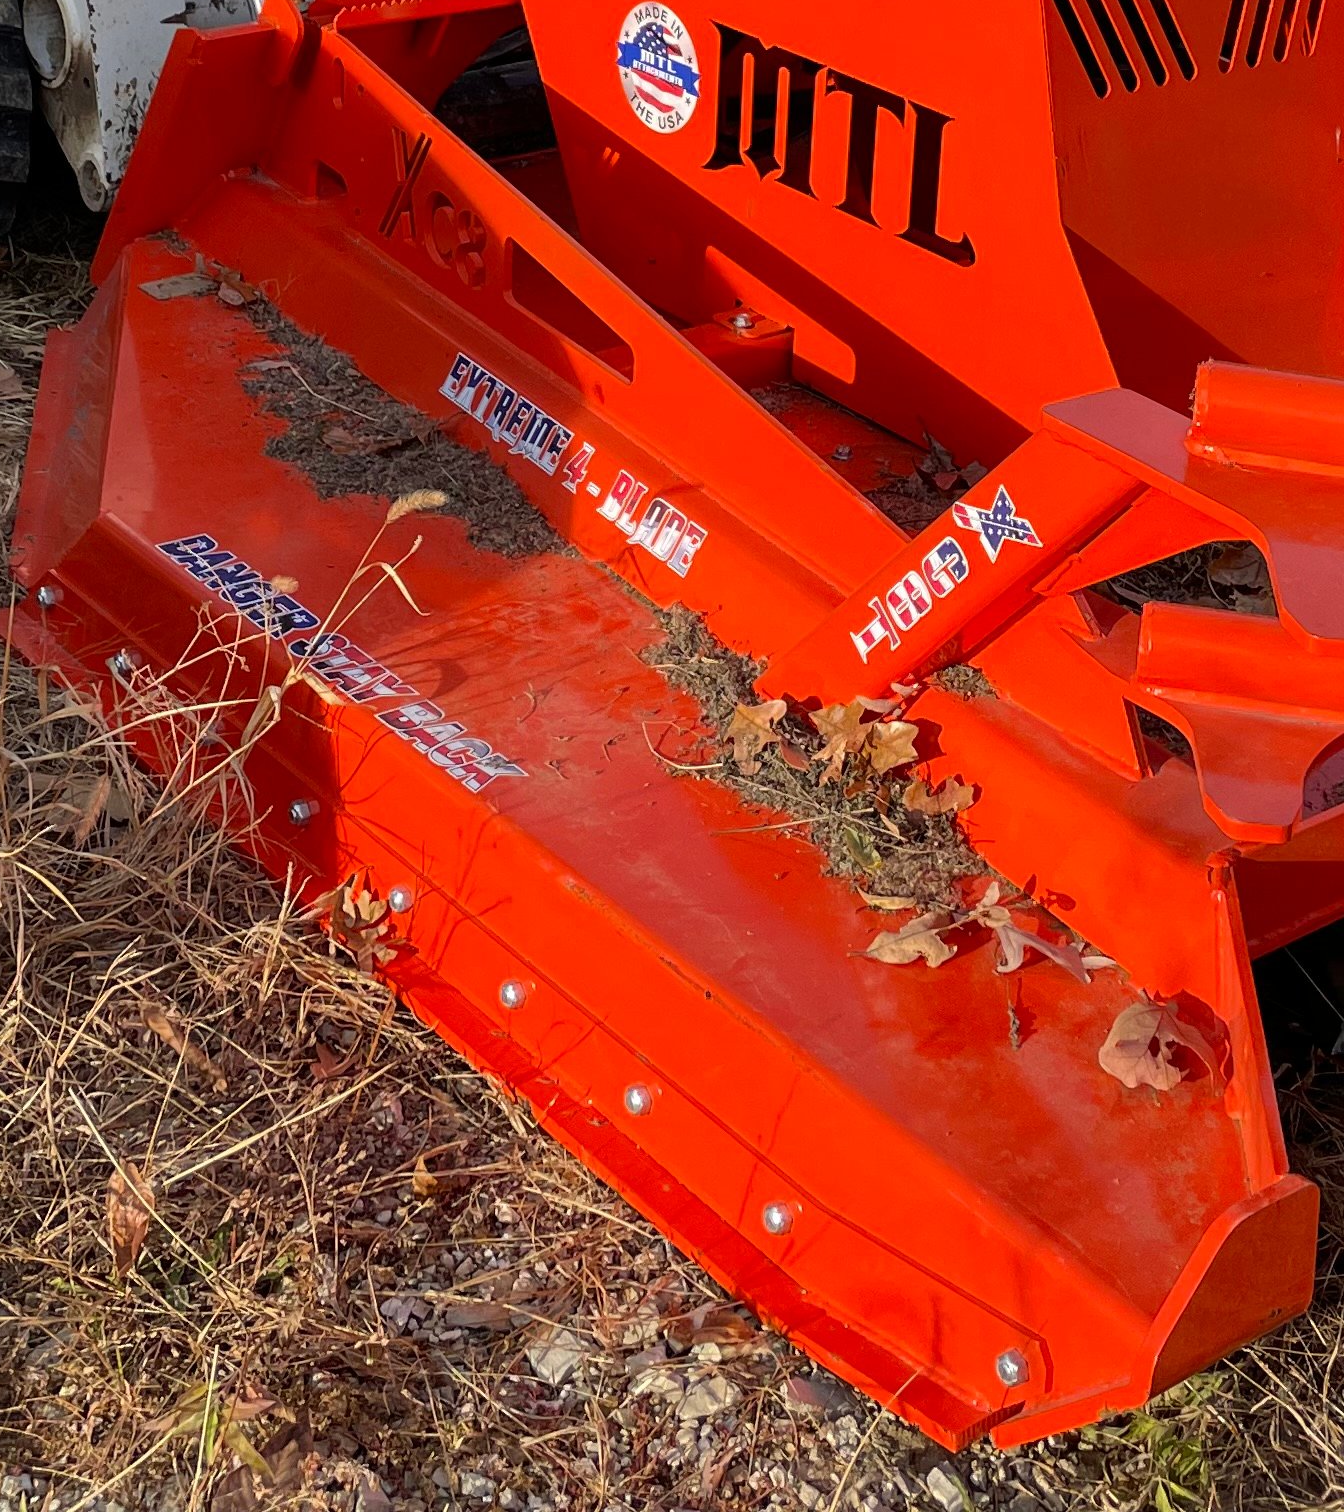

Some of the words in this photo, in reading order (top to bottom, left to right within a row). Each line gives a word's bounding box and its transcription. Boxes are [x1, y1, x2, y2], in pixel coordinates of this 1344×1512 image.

[634, 6, 668, 24] MADE
[670, 20, 684, 40] IN
[640, 48, 677, 73] MTL
[630, 92, 654, 125] THE
[658, 111, 684, 130] USA
[701, 19, 976, 268] MTL
[438, 351, 575, 476] EXTREME
[155, 533, 321, 640] DANGER
[288, 633, 421, 703] STAY
[374, 699, 529, 793] BACK
